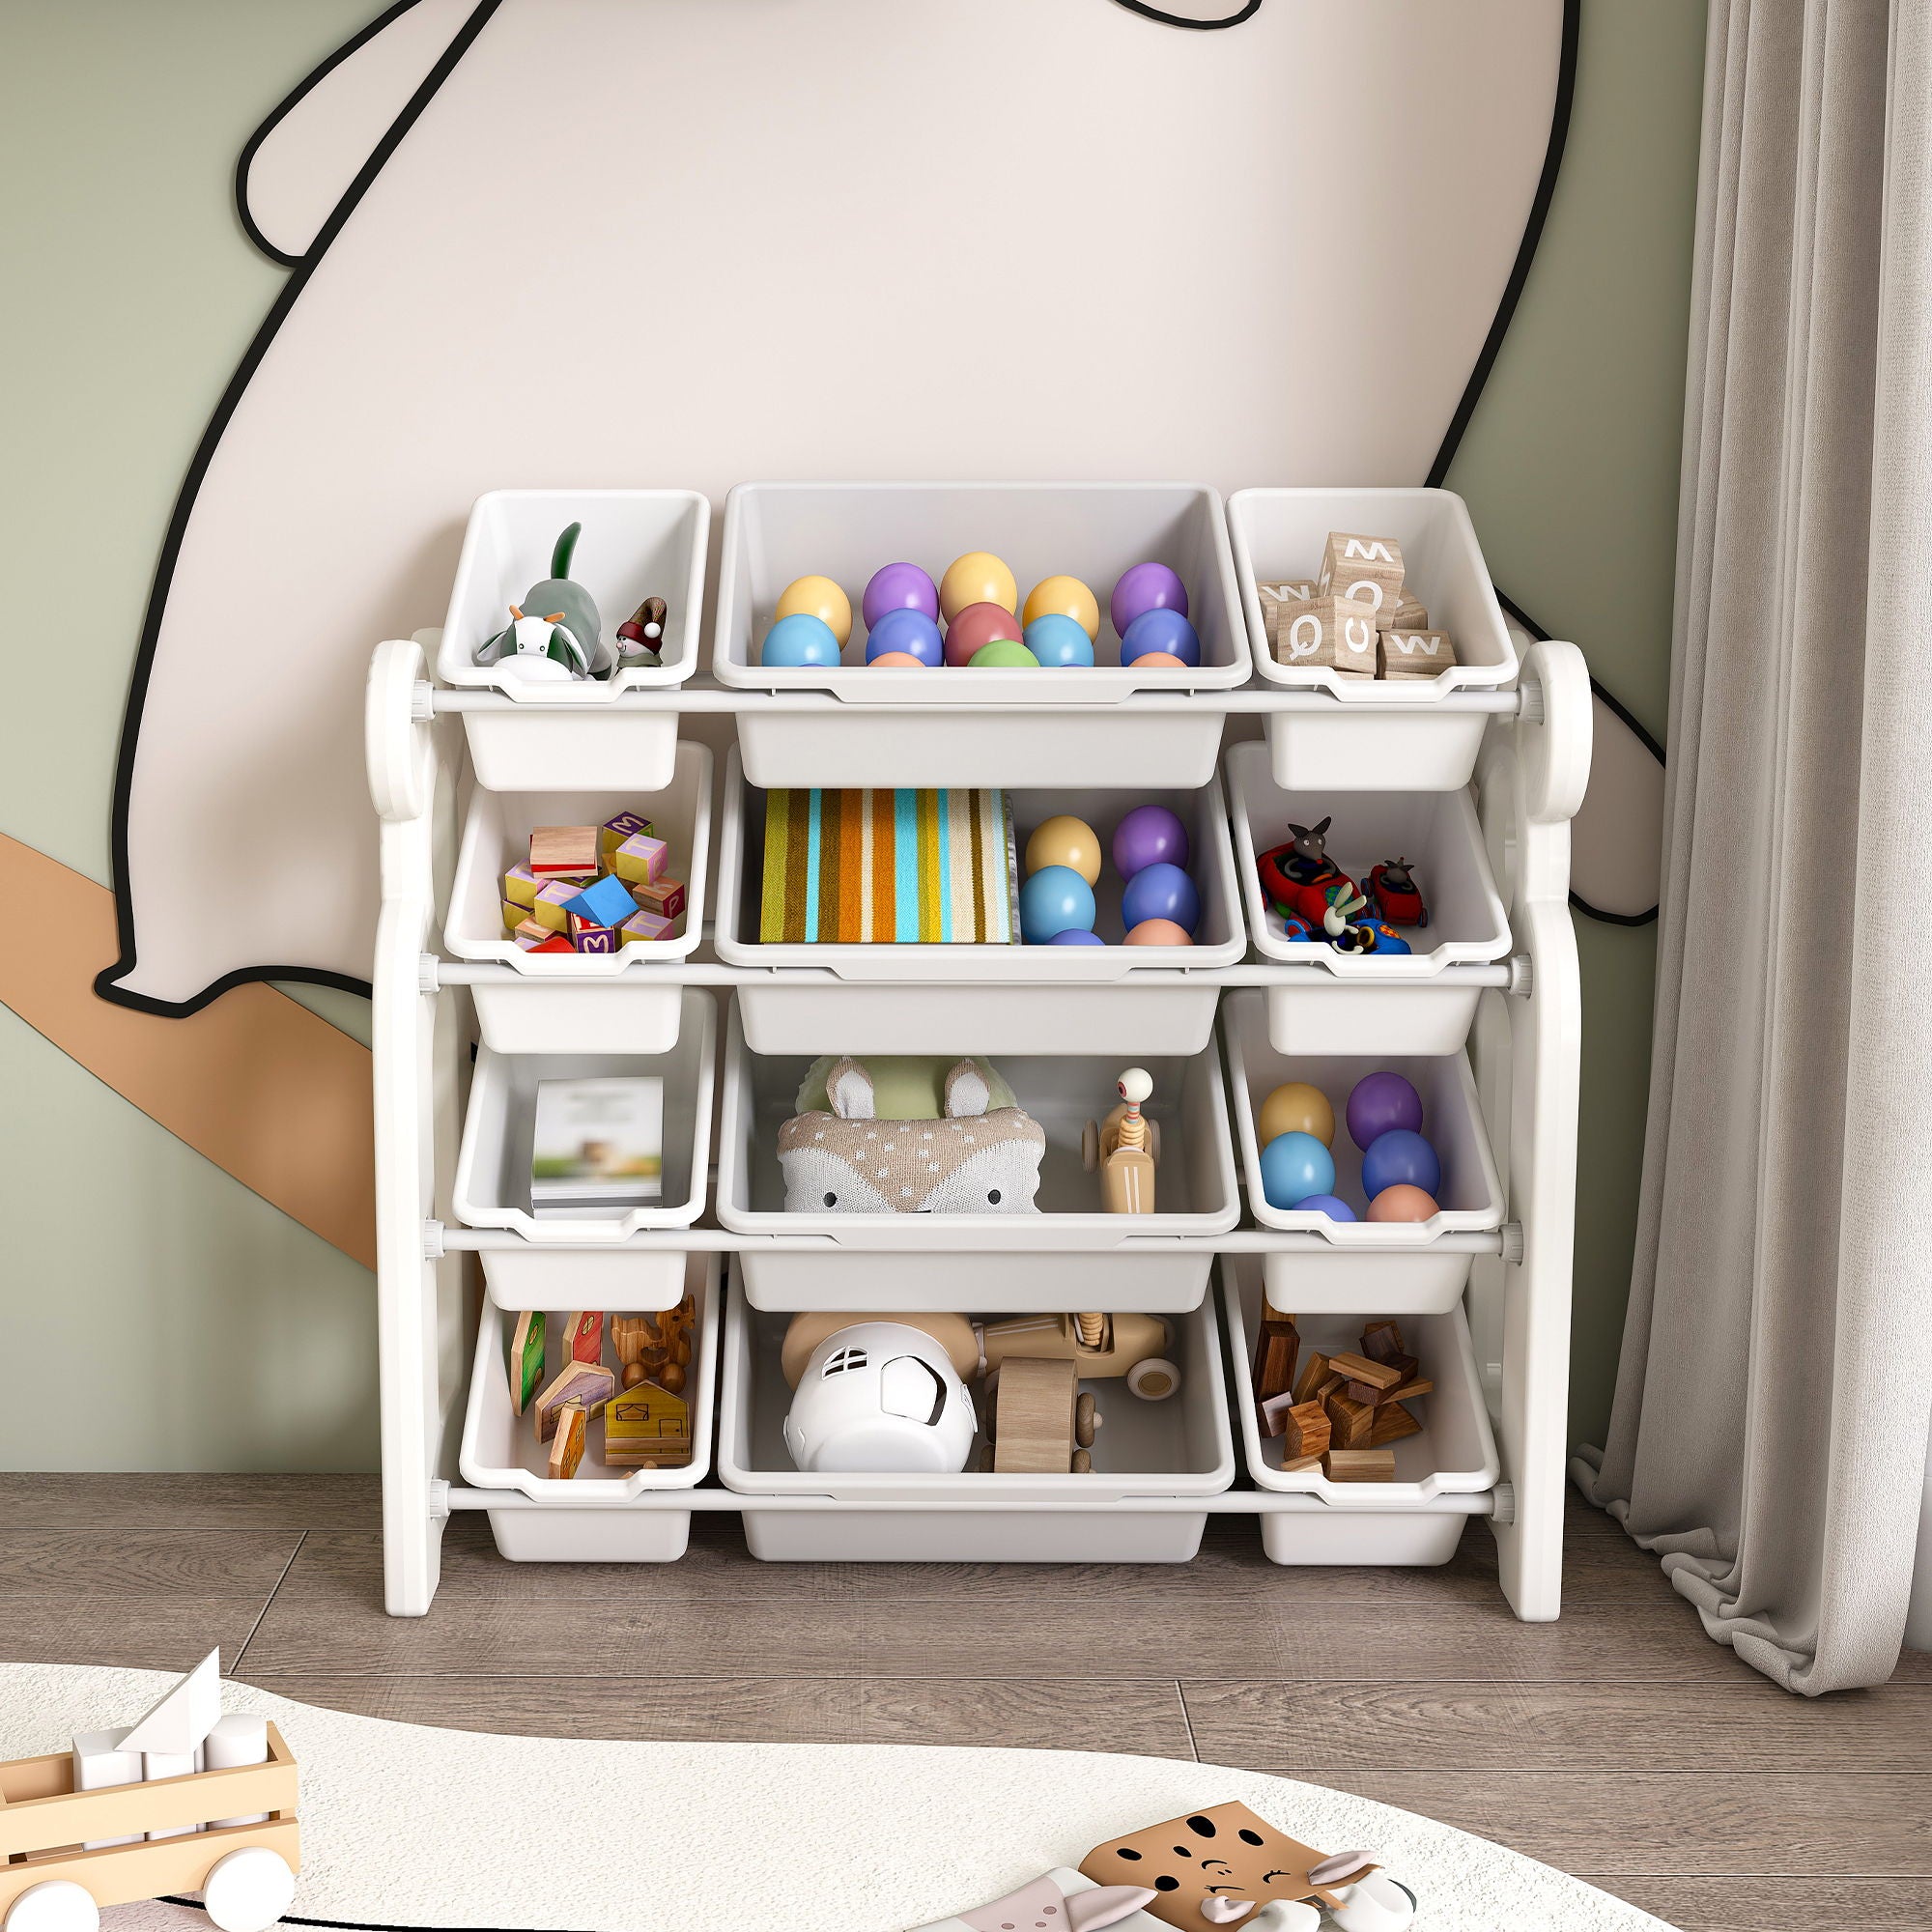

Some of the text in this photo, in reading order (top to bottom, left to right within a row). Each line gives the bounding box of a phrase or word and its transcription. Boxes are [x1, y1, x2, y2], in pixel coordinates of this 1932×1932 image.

[1290, 614, 1322, 661] Q
[1390, 635, 1441, 655] W
[612, 816, 644, 834] M
[626, 837, 657, 850] T
[632, 915, 662, 928] T
[583, 934, 609, 952] M
